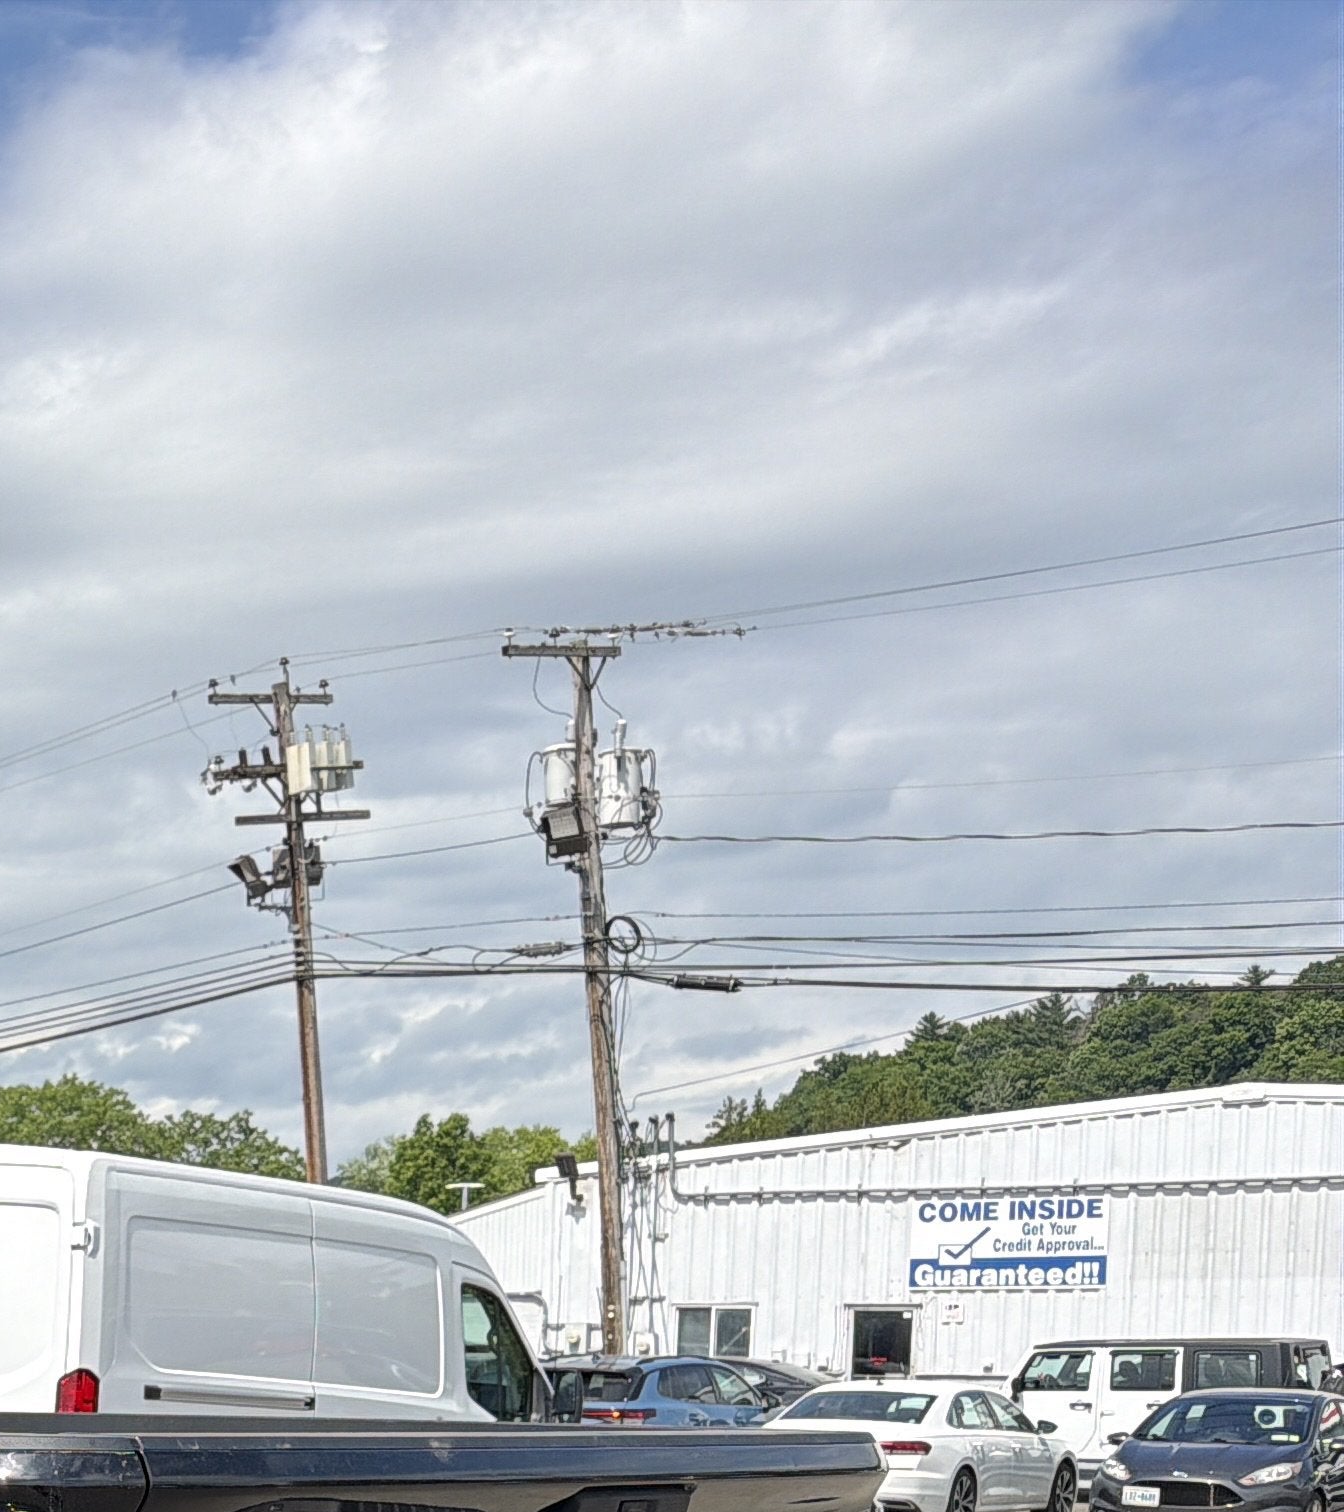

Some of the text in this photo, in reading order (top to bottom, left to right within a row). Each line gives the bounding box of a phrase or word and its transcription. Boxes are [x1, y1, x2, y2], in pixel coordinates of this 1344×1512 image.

[918, 1198, 1104, 1223] COME INSIDE
[1022, 1222, 1077, 1236] Get Your
[993, 1238, 1032, 1253] Credit
[914, 1261, 1100, 1287] Guaranteed!!
